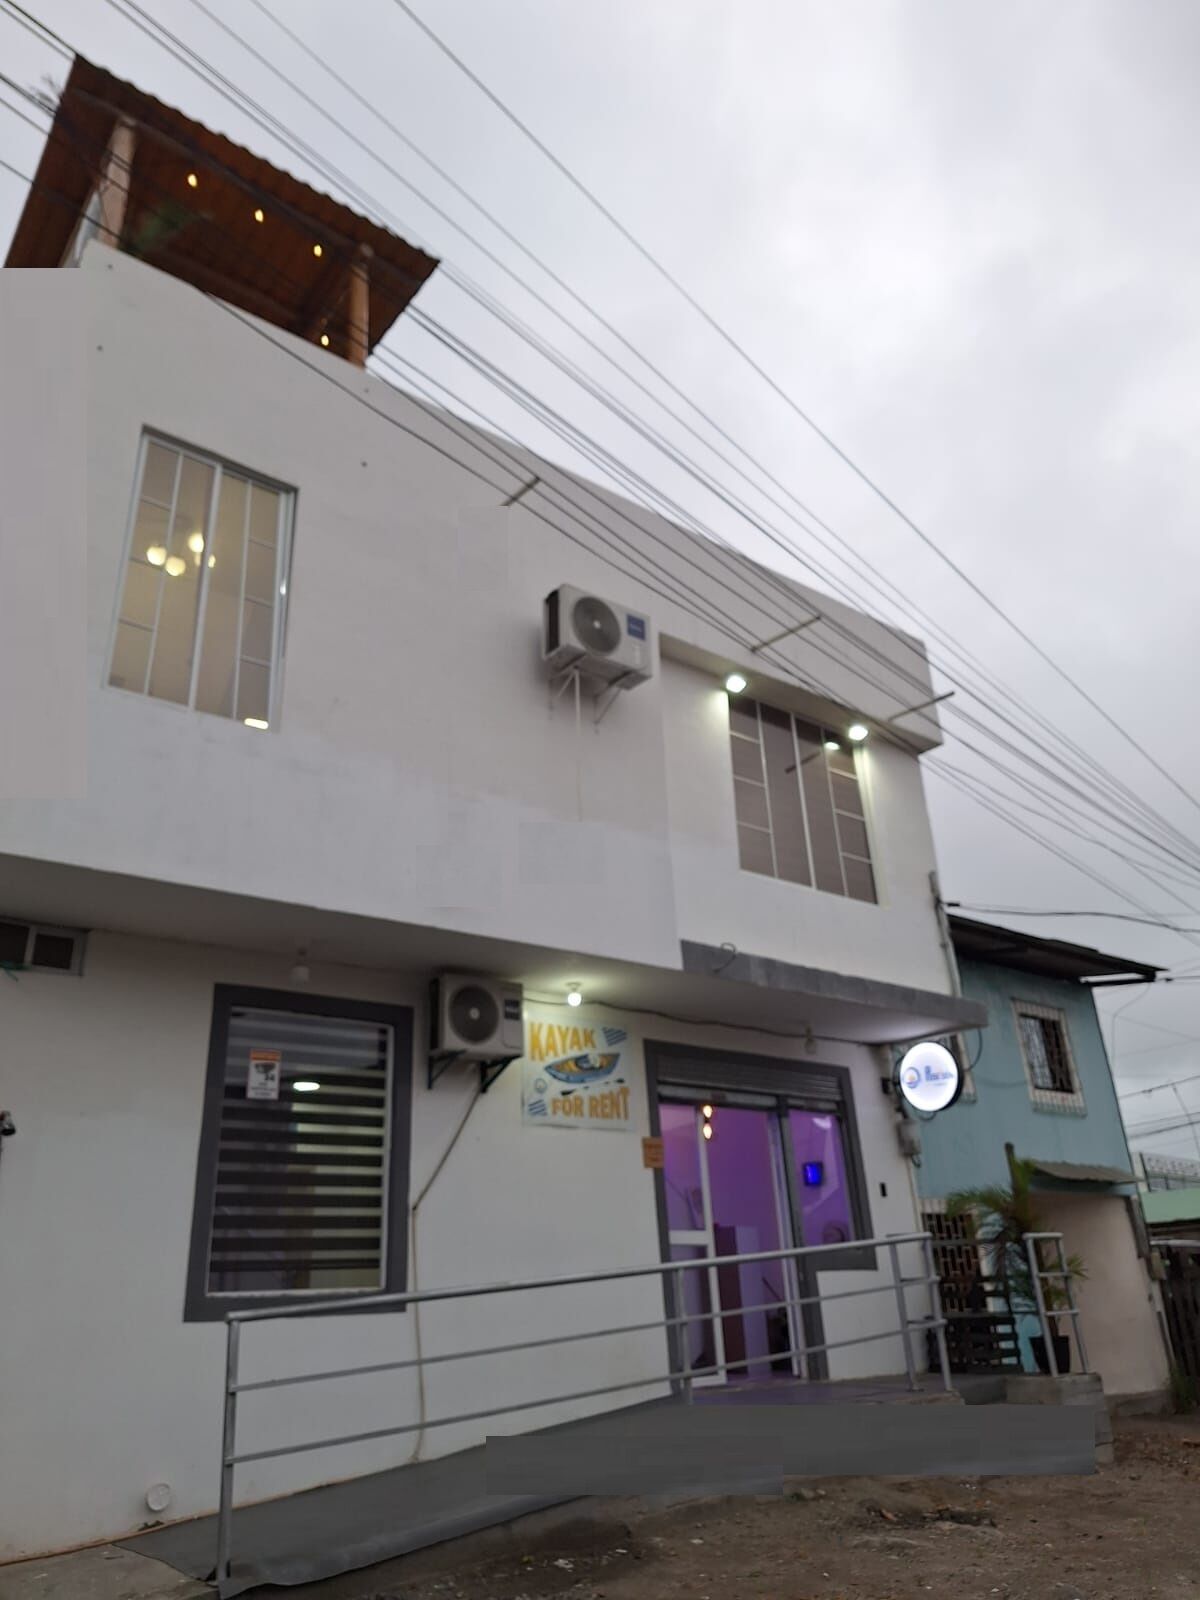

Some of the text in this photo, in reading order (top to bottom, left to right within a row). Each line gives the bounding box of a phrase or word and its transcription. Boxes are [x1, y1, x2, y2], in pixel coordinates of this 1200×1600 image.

[529, 1022, 596, 1062] KAYAK
[551, 1086, 630, 1120] FOR RENT
